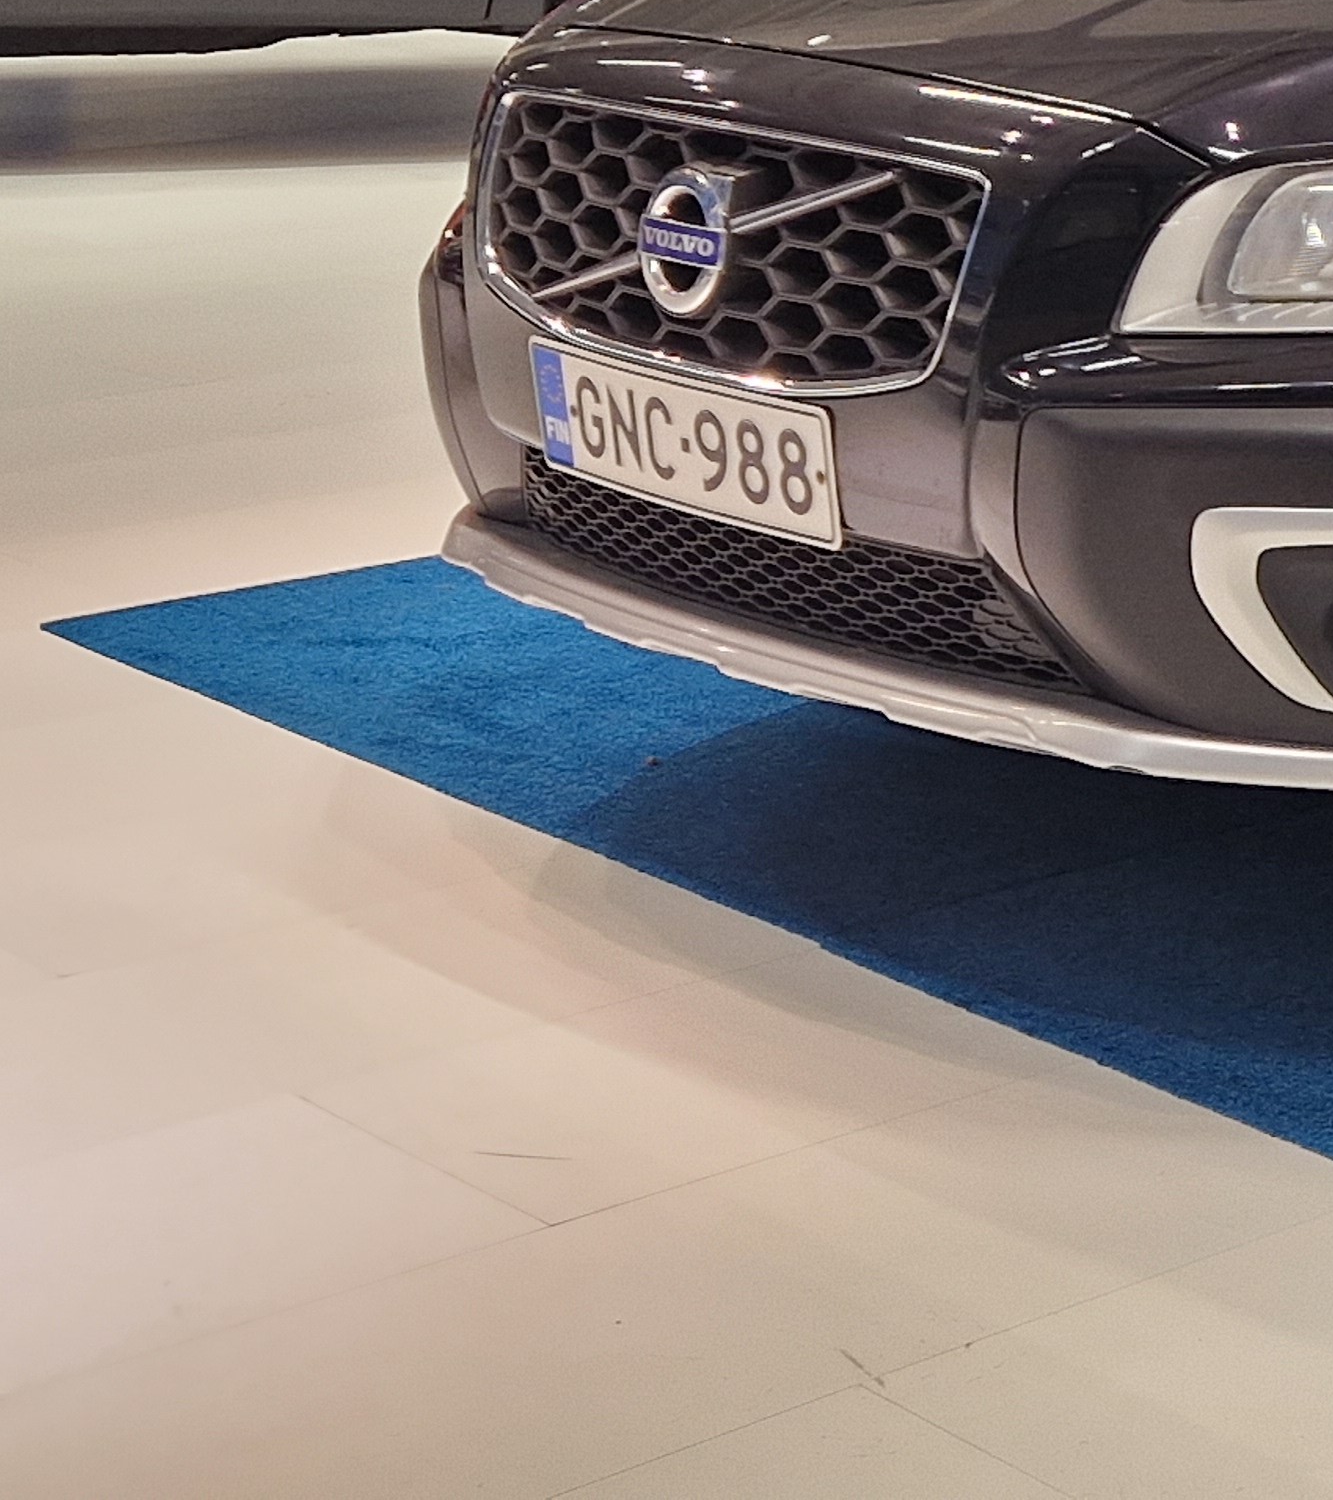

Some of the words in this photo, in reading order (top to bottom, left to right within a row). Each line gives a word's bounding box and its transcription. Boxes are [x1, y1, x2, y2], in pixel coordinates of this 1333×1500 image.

[643, 225, 715, 257] VOLVO
[545, 415, 571, 445] FIN
[575, 376, 813, 516] GNC-988
